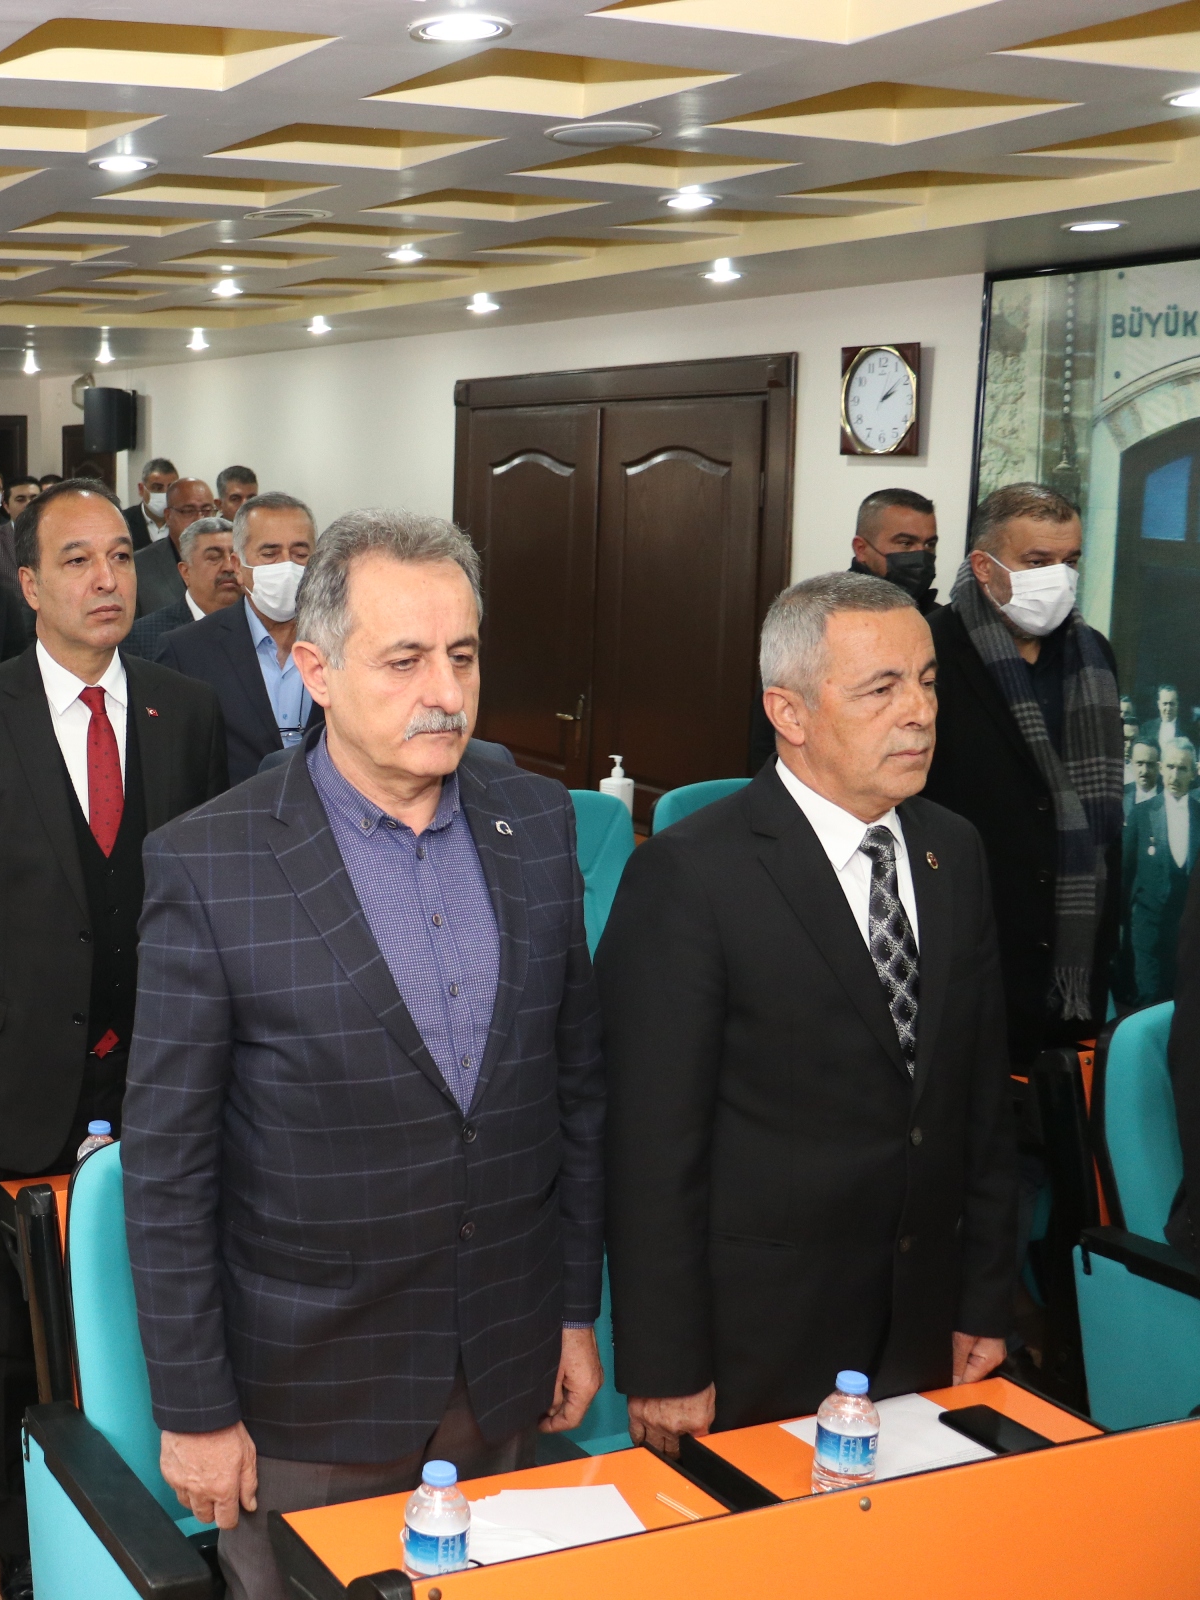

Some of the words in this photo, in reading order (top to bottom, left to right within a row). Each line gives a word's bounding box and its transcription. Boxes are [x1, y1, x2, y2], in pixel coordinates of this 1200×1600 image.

[1111, 304, 1198, 338] BÜYÜK
[878, 357, 889, 368] 12
[894, 362, 899, 373] 1
[868, 363, 875, 374] 11
[857, 376, 867, 387] 10
[902, 374, 910, 386] 2
[852, 396, 860, 407] 9
[906, 394, 914, 406] 3
[855, 414, 863, 425] 8
[865, 427, 872, 440] 7
[878, 432, 886, 444] 6
[891, 427, 899, 438] 5
